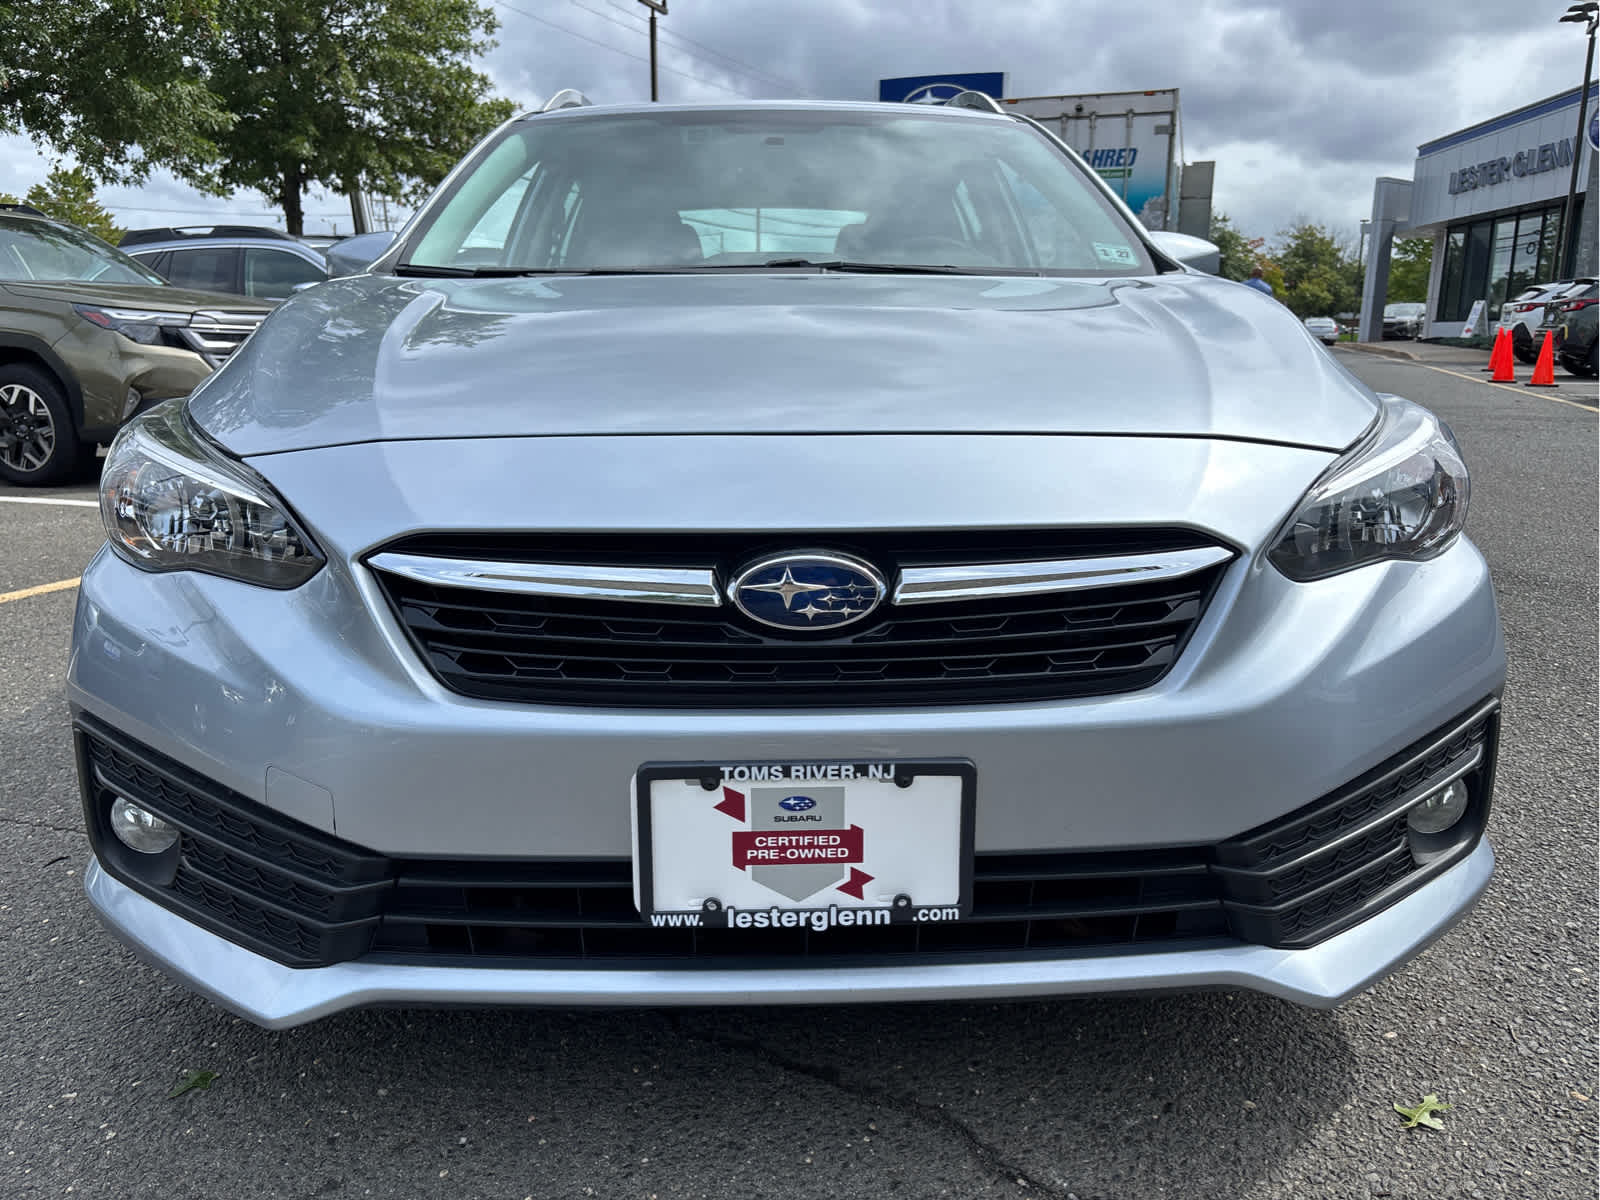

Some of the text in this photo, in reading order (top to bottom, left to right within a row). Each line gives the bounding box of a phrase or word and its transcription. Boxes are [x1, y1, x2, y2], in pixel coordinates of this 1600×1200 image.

[1448, 155, 1512, 195] LESTER
[720, 766, 784, 782] TOMS
[868, 764, 896, 779] NJ
[774, 815, 823, 823] SUBARU
[755, 835, 841, 848] CERTIFIED
[747, 847, 849, 860] PRE-OWNED
[650, 906, 960, 932] www. lesterglenn .com
